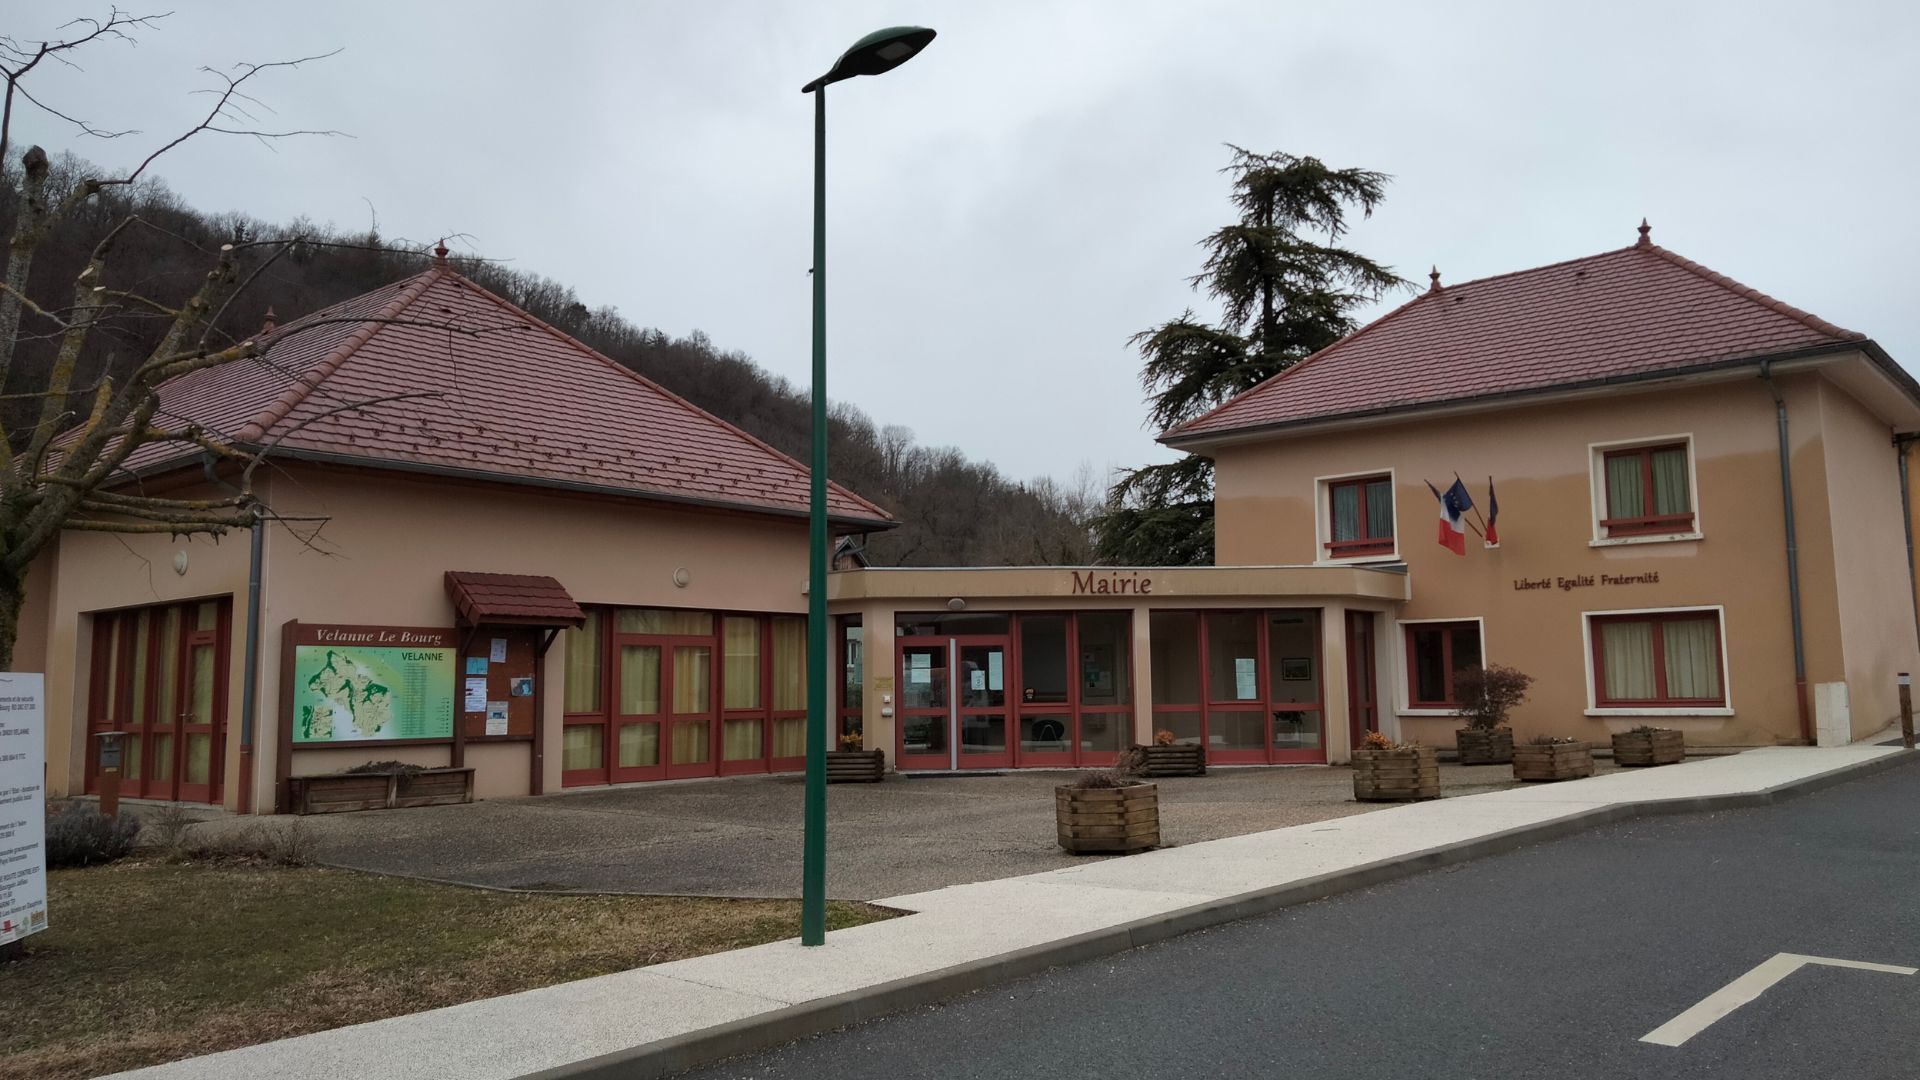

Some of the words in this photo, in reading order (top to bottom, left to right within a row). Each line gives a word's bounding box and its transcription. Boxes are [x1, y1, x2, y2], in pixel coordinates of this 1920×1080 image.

[1072, 571, 1152, 594] Mairie
[1514, 577, 1551, 590] Liberté
[1557, 574, 1595, 591] Egalité
[1601, 571, 1659, 585] Fraternité
[317, 629, 374, 642] Velanne
[380, 631, 396, 642] Le
[401, 631, 442, 646] Bourg
[402, 652, 444, 661] VELANNE
